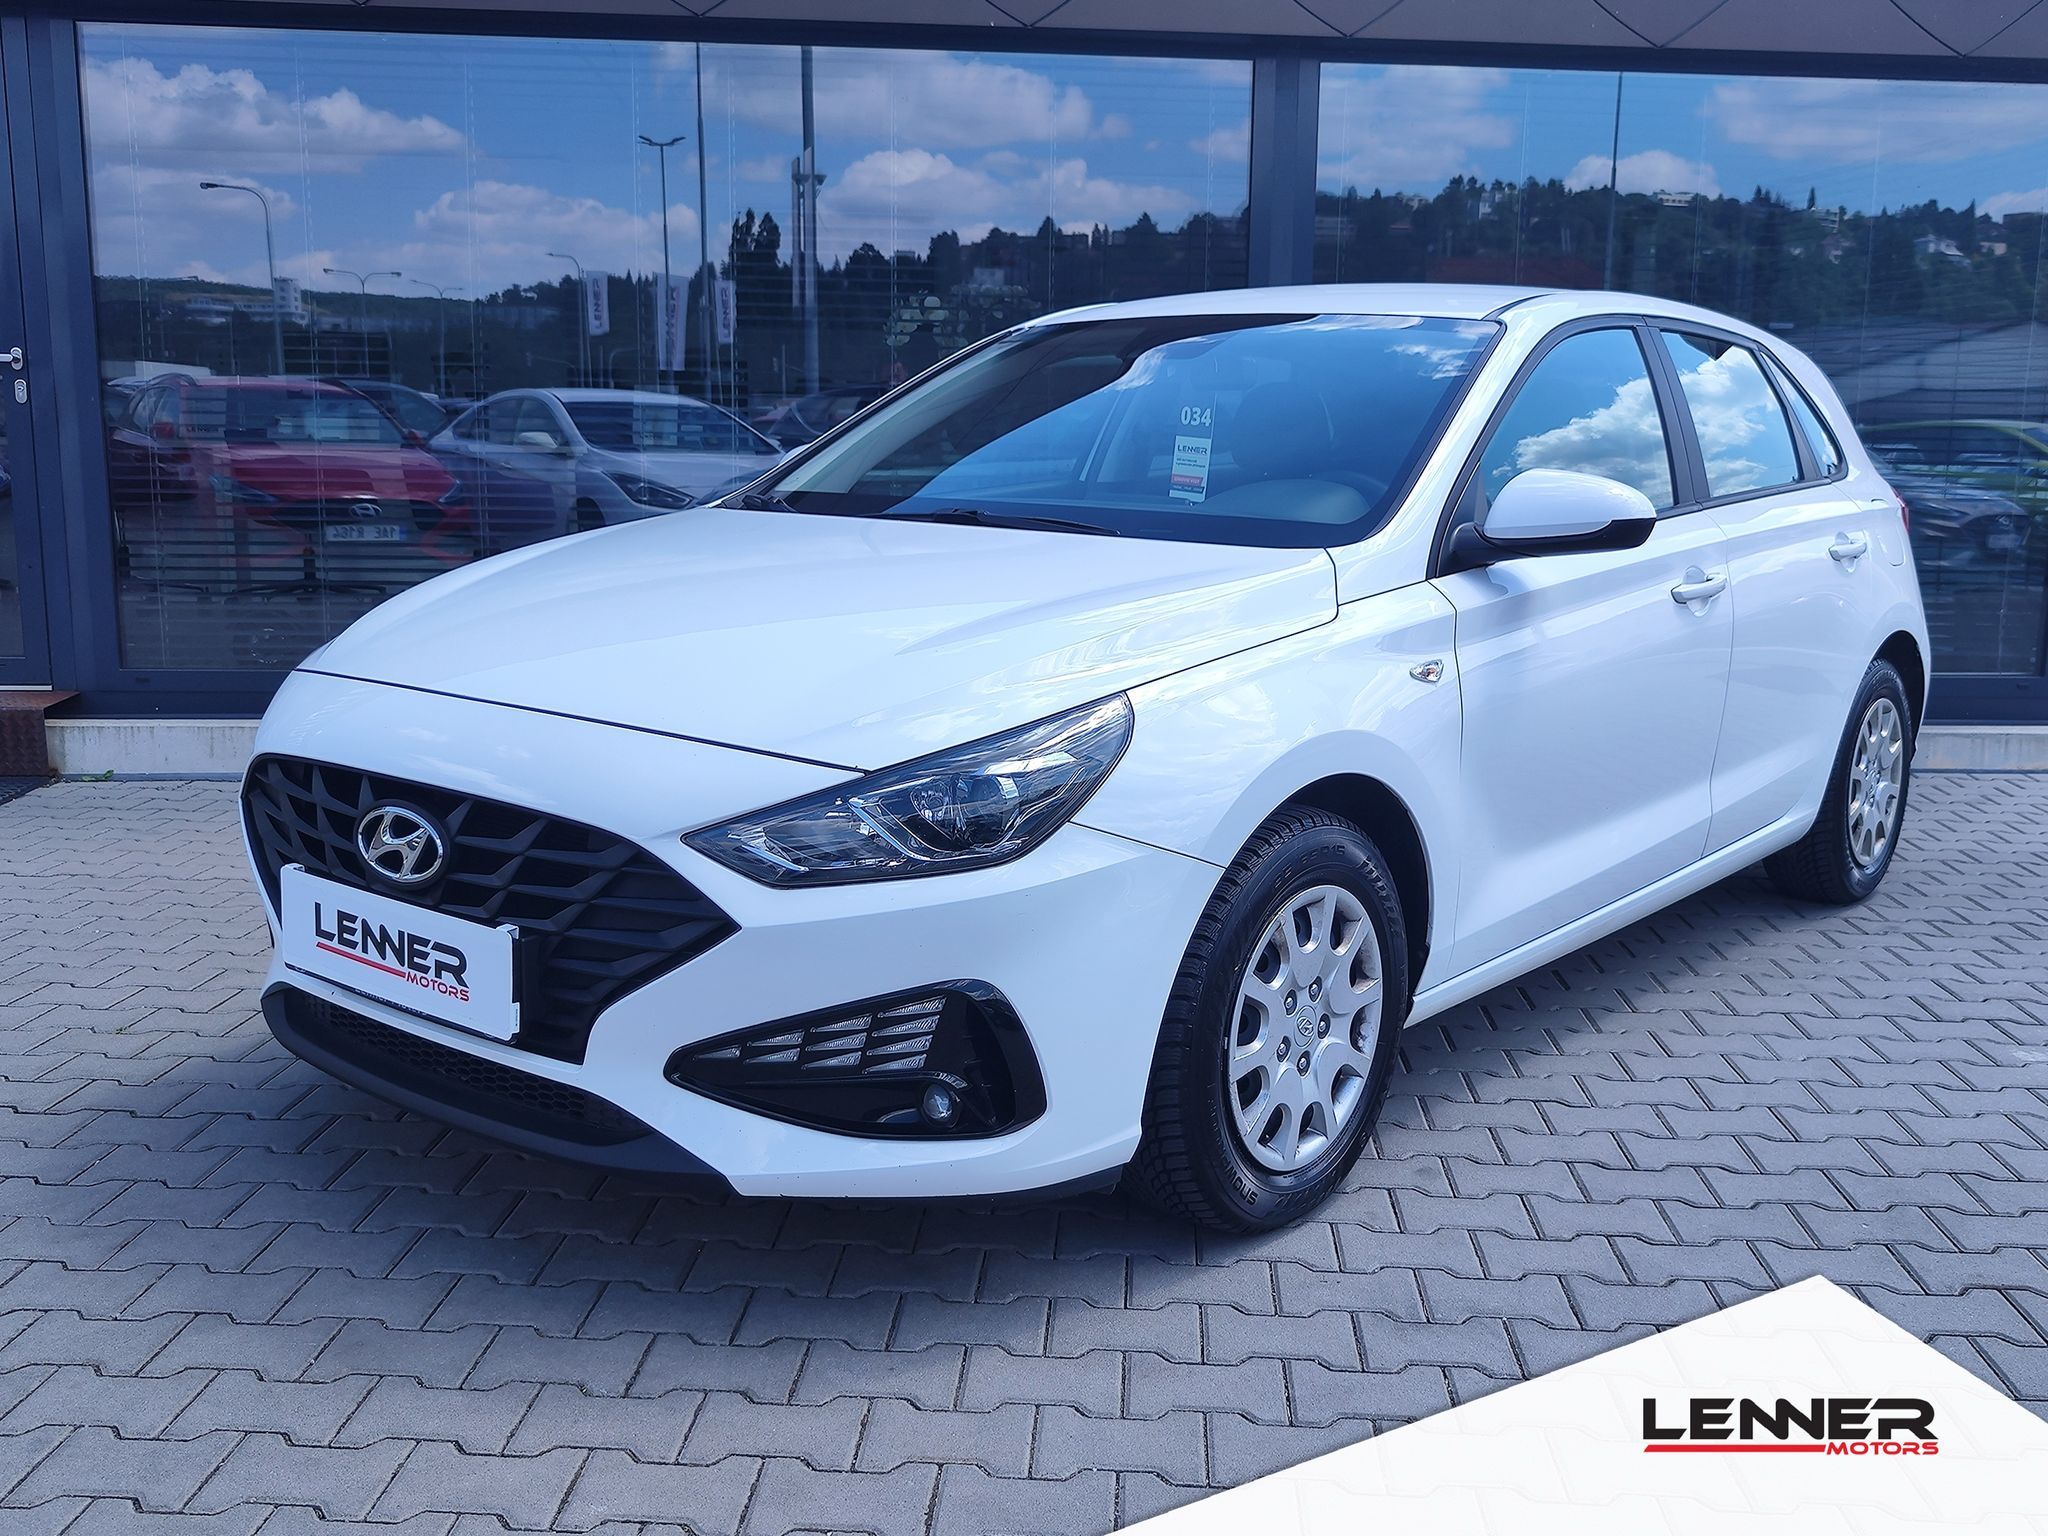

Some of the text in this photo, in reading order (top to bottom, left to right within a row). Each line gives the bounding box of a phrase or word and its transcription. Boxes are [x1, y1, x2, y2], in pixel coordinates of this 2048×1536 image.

[1180, 406, 1211, 427] 034
[1177, 444, 1208, 455] LENNER
[314, 901, 469, 989] LENNER
[406, 971, 470, 1002] MOTORS
